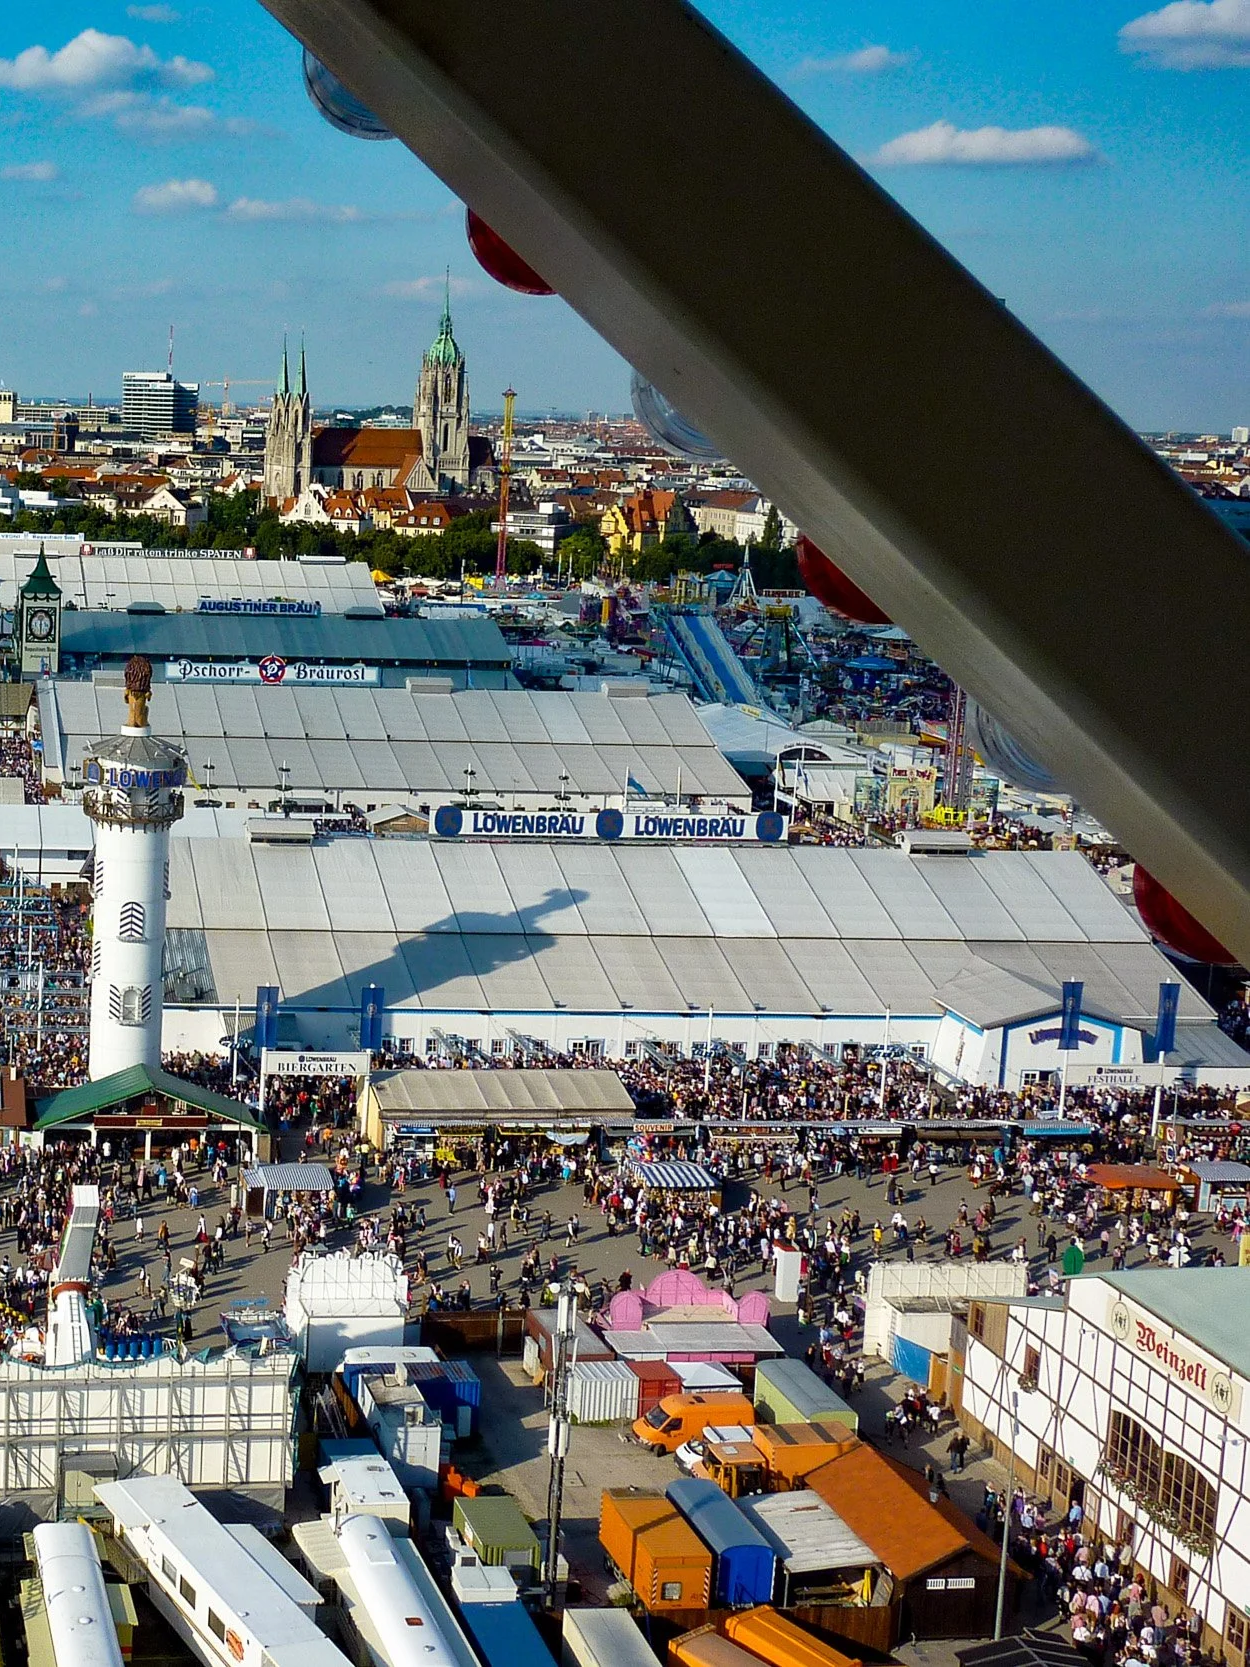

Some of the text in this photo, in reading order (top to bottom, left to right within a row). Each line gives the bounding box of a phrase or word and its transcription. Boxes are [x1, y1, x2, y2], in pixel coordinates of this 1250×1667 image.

[164, 548, 197, 558] trinke
[200, 549, 242, 559] SPATEN
[200, 601, 313, 614] AUGUSTINER BRÄU
[473, 811, 585, 835] LÖWENBRÄU
[634, 815, 745, 837] LÖWENBRÄU
[278, 1062, 357, 1072] BIERGARTEN
[1087, 1075, 1141, 1084] FESTHALLE
[1135, 1318, 1207, 1391] Weinzelt
